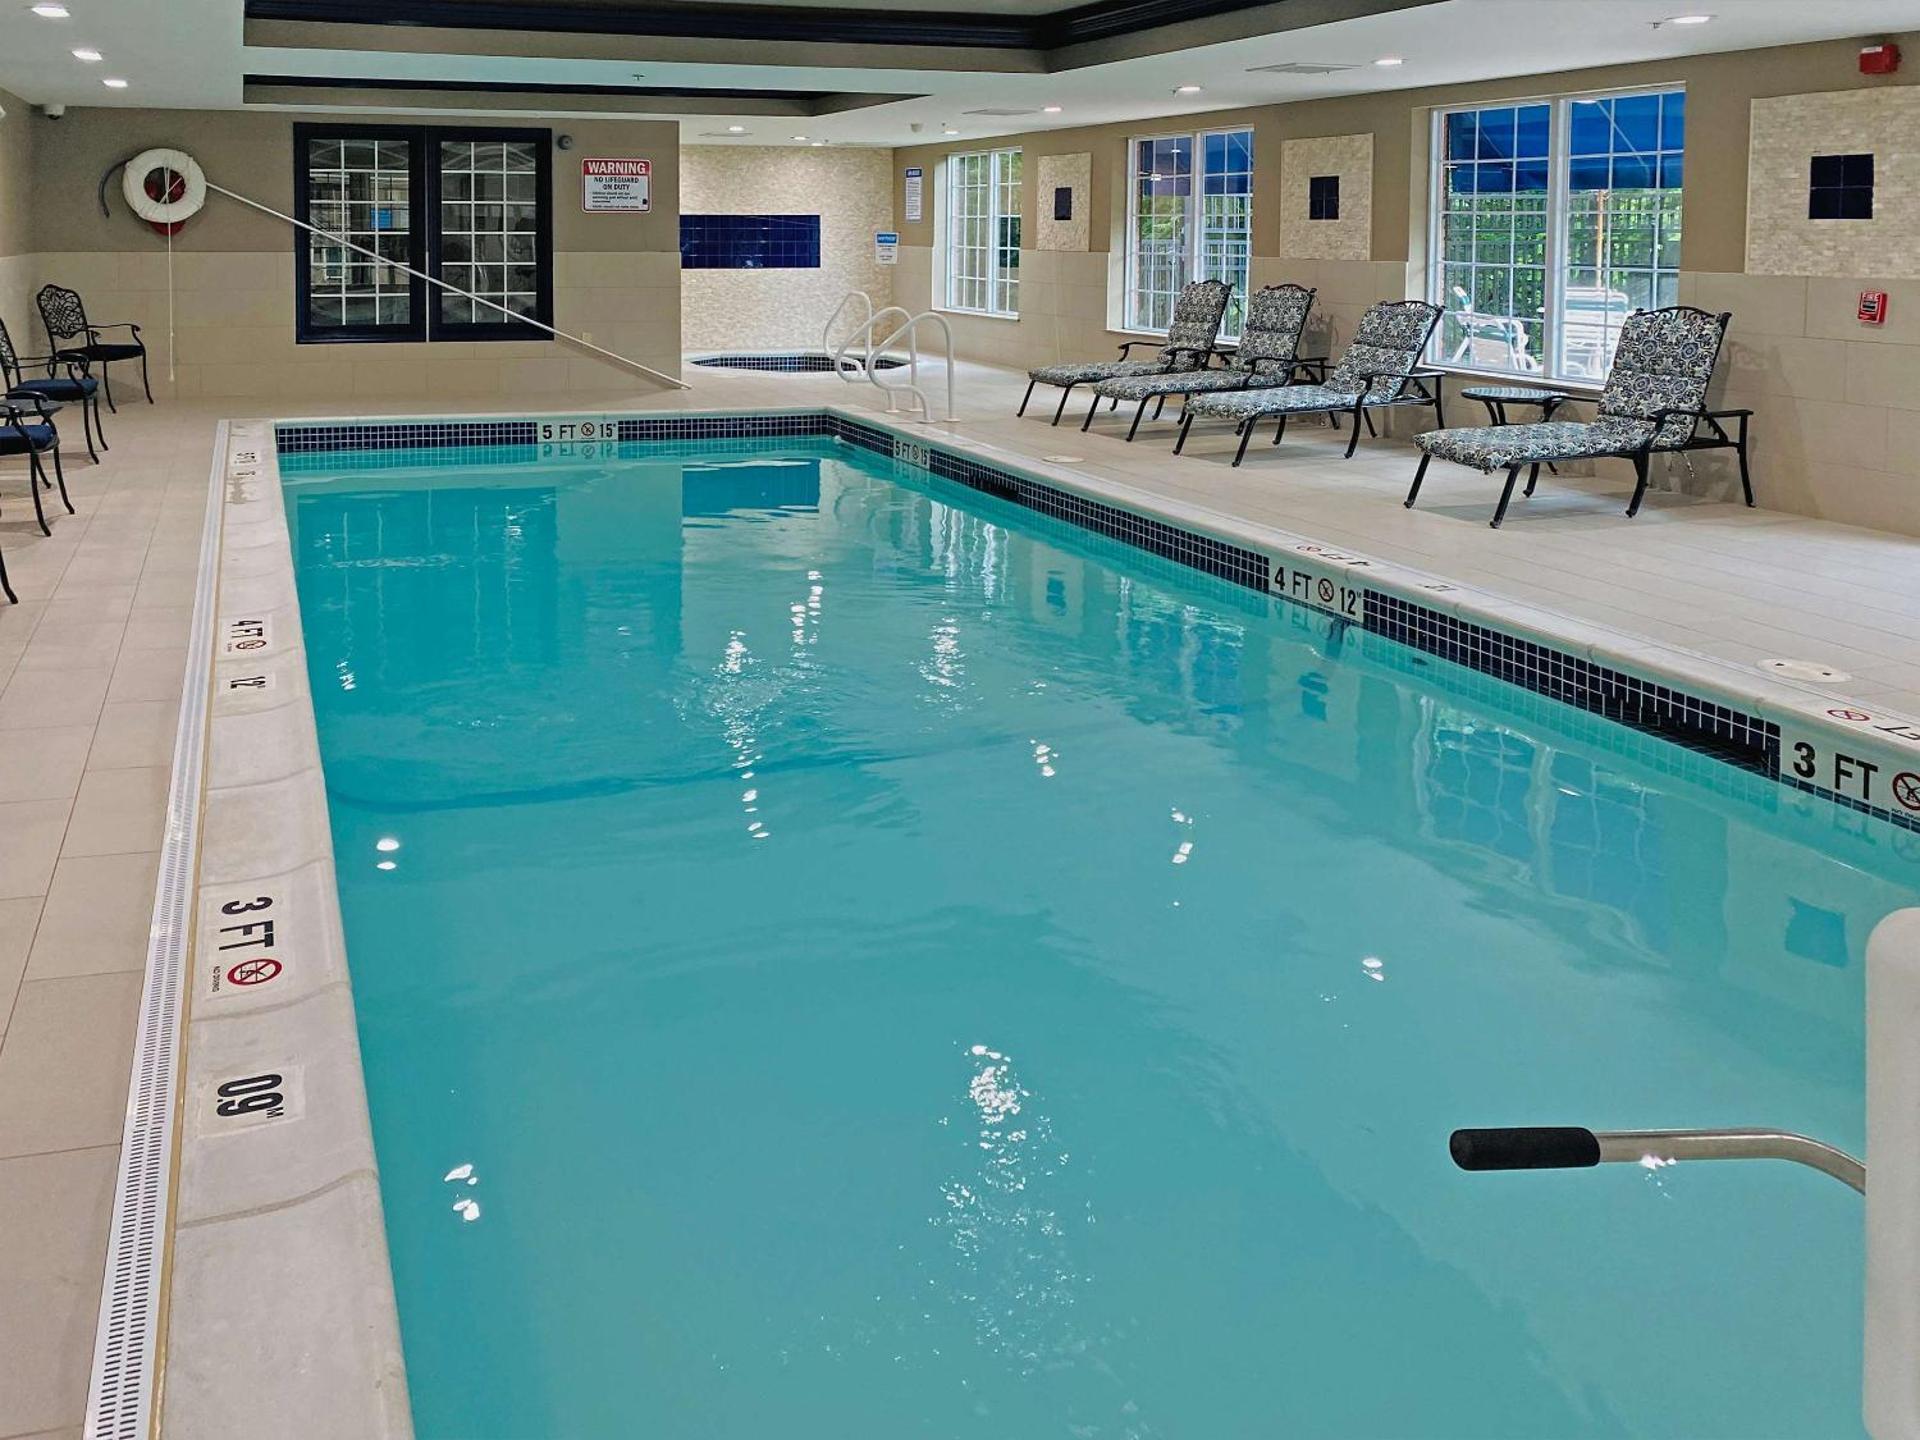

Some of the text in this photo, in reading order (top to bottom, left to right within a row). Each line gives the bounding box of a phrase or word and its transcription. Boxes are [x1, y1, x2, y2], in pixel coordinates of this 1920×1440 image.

[587, 161, 646, 174] WARNING
[605, 176, 640, 184] LIFEGUARD
[614, 183, 631, 191] DUTY
[542, 424, 553, 440] 5
[559, 424, 576, 440] FT
[902, 442, 911, 460] FT
[1274, 566, 1286, 591] 4
[1292, 570, 1313, 600] FT
[230, 620, 264, 639] 4 FT
[1792, 740, 1879, 801] 3 FT
[218, 895, 275, 952] 3 FT
